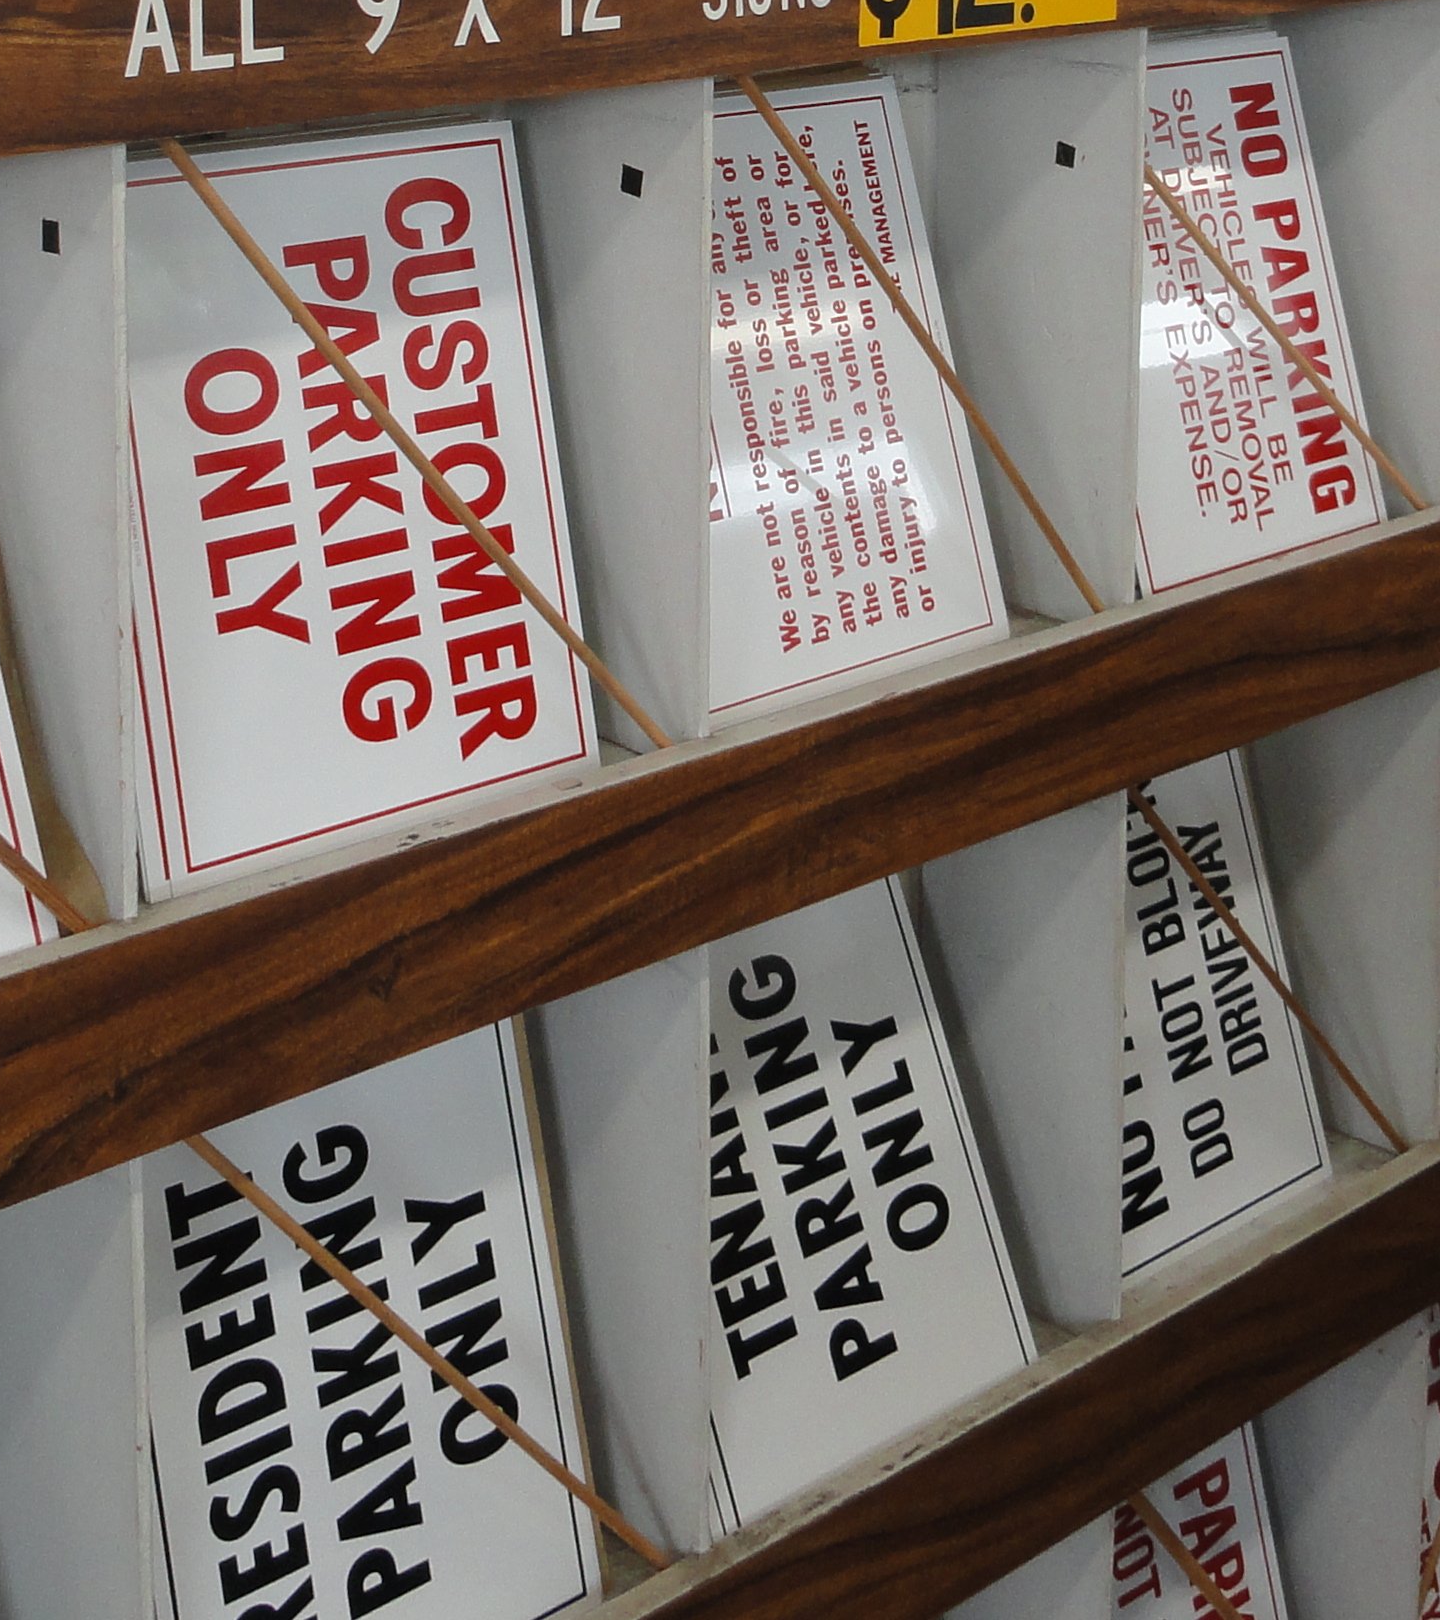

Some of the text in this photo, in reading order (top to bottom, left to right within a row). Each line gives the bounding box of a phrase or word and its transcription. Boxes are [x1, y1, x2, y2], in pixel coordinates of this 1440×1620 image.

[853, 119, 896, 266] MANAGEMENT
[1148, 106, 1248, 526] AT AND/OR
[1171, 86, 1275, 532] SUBJECT REMOVAL
[1204, 122, 1293, 486] VEHICLES WILL BE
[1228, 81, 1357, 515] NO PARKING
[183, 346, 312, 645] ONLY
[282, 233, 434, 743] PARKING
[384, 176, 539, 762] CUSTOMER
[728, 338, 802, 654] We are not responsible
[734, 194, 817, 599] reason loss theft
[760, 196, 844, 579] vehicle this parking area
[797, 236, 882, 627] the contents said vehicle,
[833, 301, 898, 564] damage vehicle
[872, 339, 927, 573] injury persons
[1164, 323, 1219, 519] EXPENSE.
[831, 1014, 951, 1253] ONLY
[1152, 974, 1234, 1179] DO NOT
[1176, 821, 1270, 1075] DRIVEWAY
[403, 1191, 520, 1465] ONLY
[729, 954, 899, 1382] PARKING
[165, 1171, 316, 1620] RESIDENT
[282, 1124, 433, 1620] PARKING
